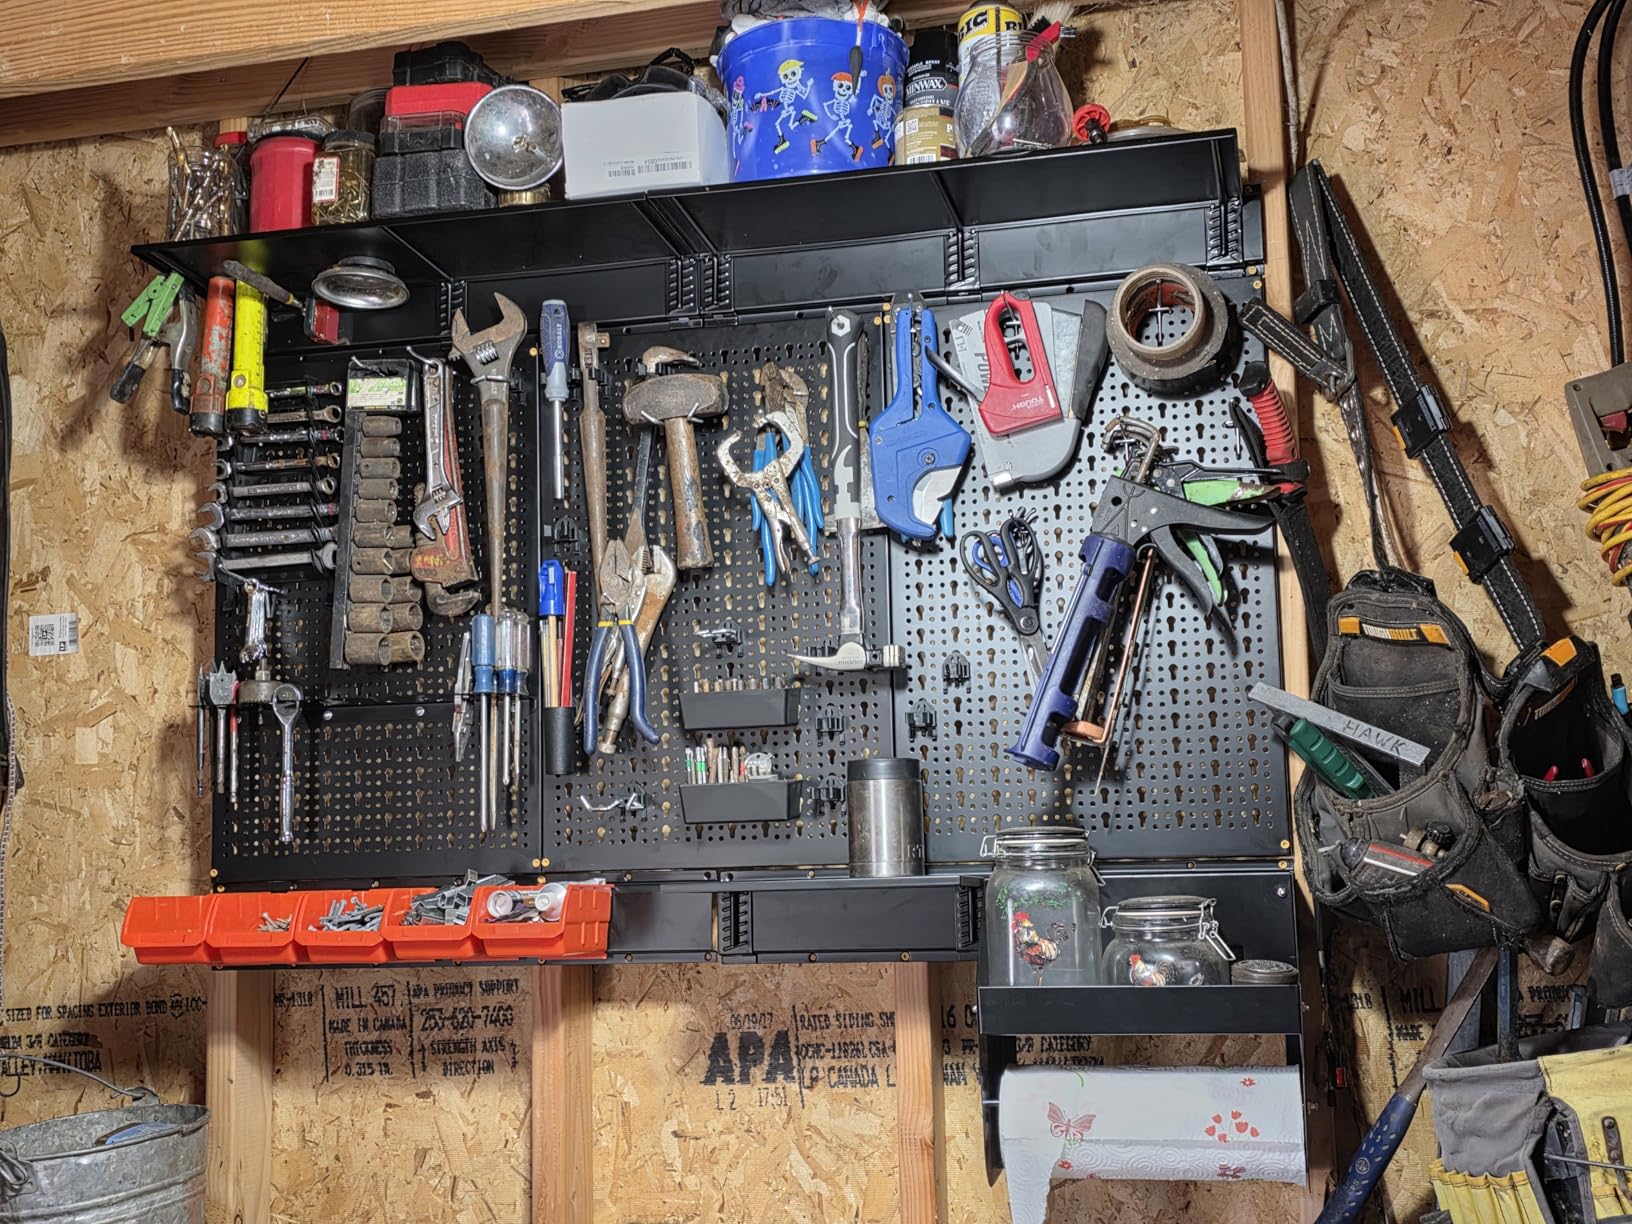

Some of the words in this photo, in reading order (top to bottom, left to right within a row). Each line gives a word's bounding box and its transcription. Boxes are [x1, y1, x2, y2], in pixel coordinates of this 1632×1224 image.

[906, 79, 944, 97] MINWAX
[1343, 719, 1408, 755] HAWK
[335, 986, 367, 1009] MILL
[372, 984, 396, 1007] 457
[479, 979, 519, 996] SUPPORT
[6, 1007, 31, 1022] SIZED
[36, 1005, 52, 1020] FOR
[57, 1003, 94, 1019] SPACING
[98, 1001, 141, 1017] EXTERIOR
[145, 1000, 167, 1015] BOND
[329, 1019, 351, 1034] MADE
[358, 1017, 369, 1032] IN
[373, 1016, 406, 1032] CANADA
[800, 1013, 830, 1031] RATED
[836, 1011, 874, 1029] SIDING
[344, 1040, 392, 1056] THICKNESS
[430, 1038, 477, 1055] STRENGTH
[700, 1029, 796, 1085] APA
[442, 1059, 495, 1077] DIRECTION
[828, 1064, 880, 1088] CANADA
